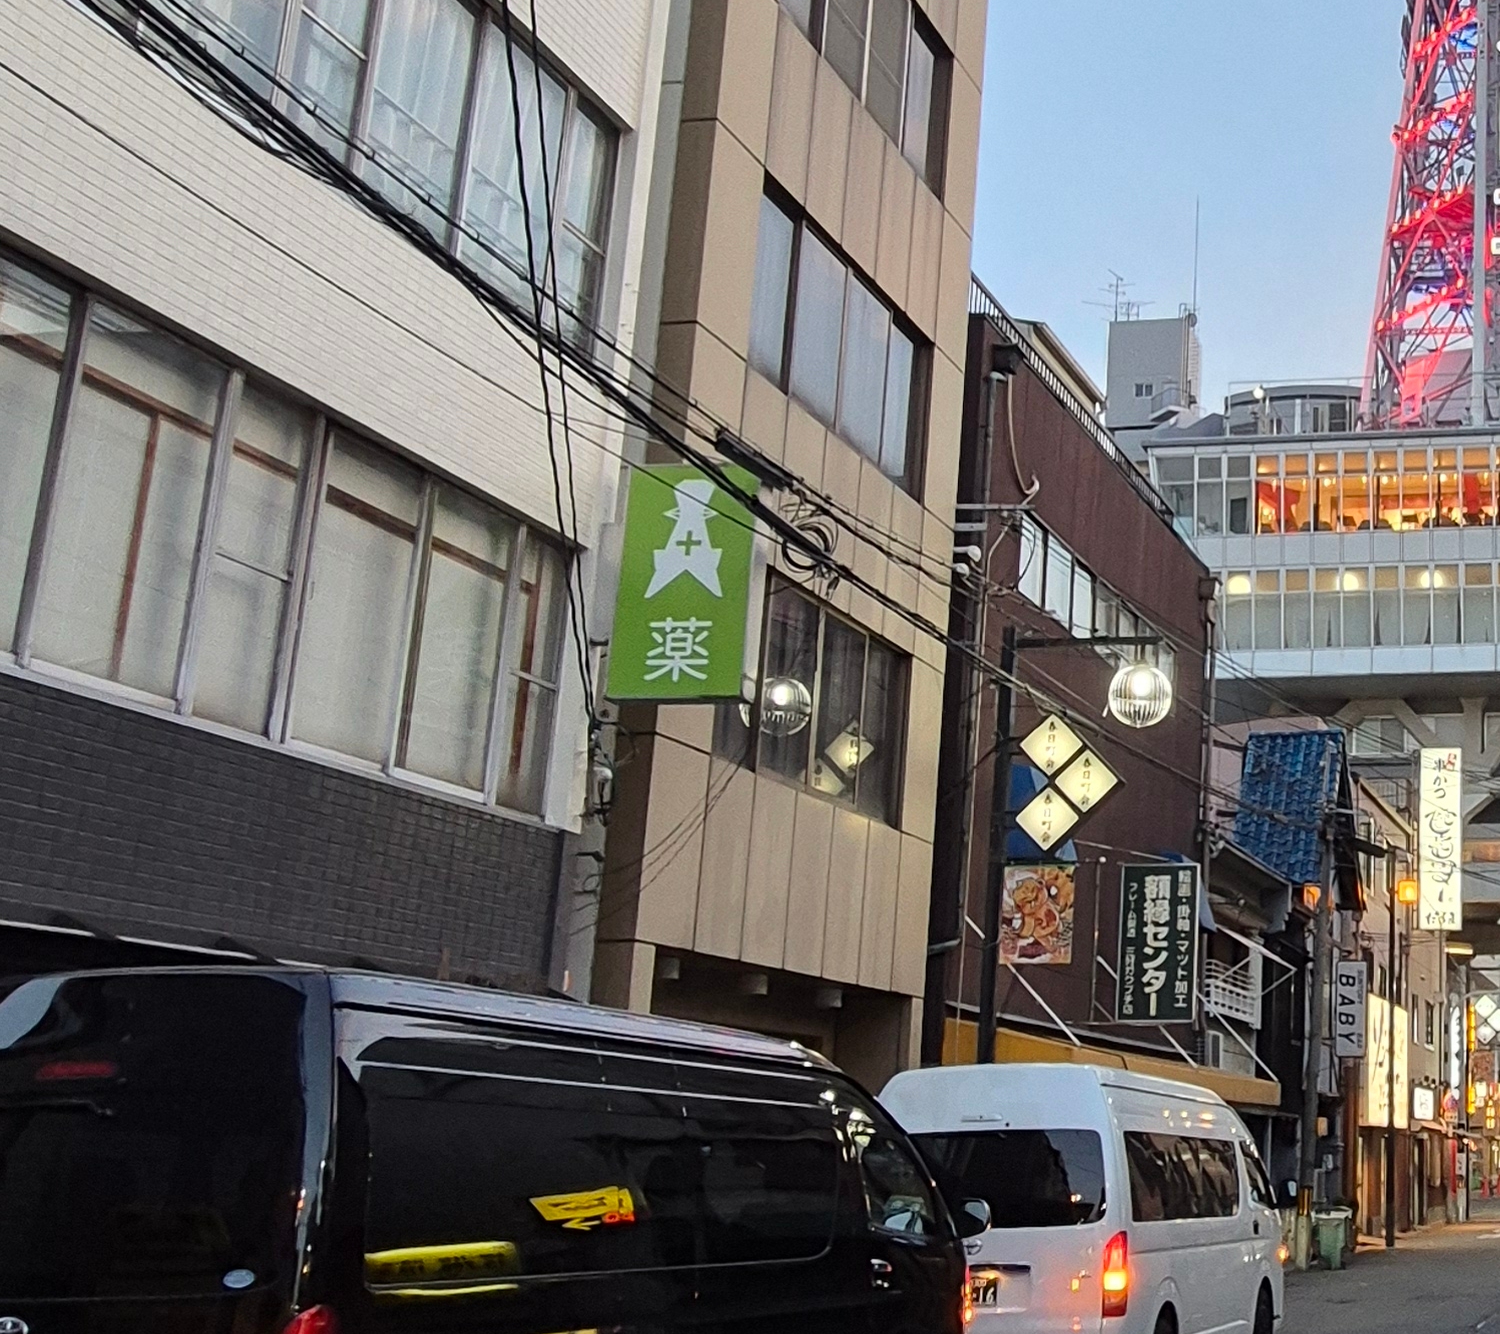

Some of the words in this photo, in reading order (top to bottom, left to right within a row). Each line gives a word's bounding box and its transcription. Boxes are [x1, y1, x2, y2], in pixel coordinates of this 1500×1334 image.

[643, 616, 714, 683] 薬
[1141, 874, 1172, 1017] 額縁センター
[1338, 973, 1356, 1045] BABY
